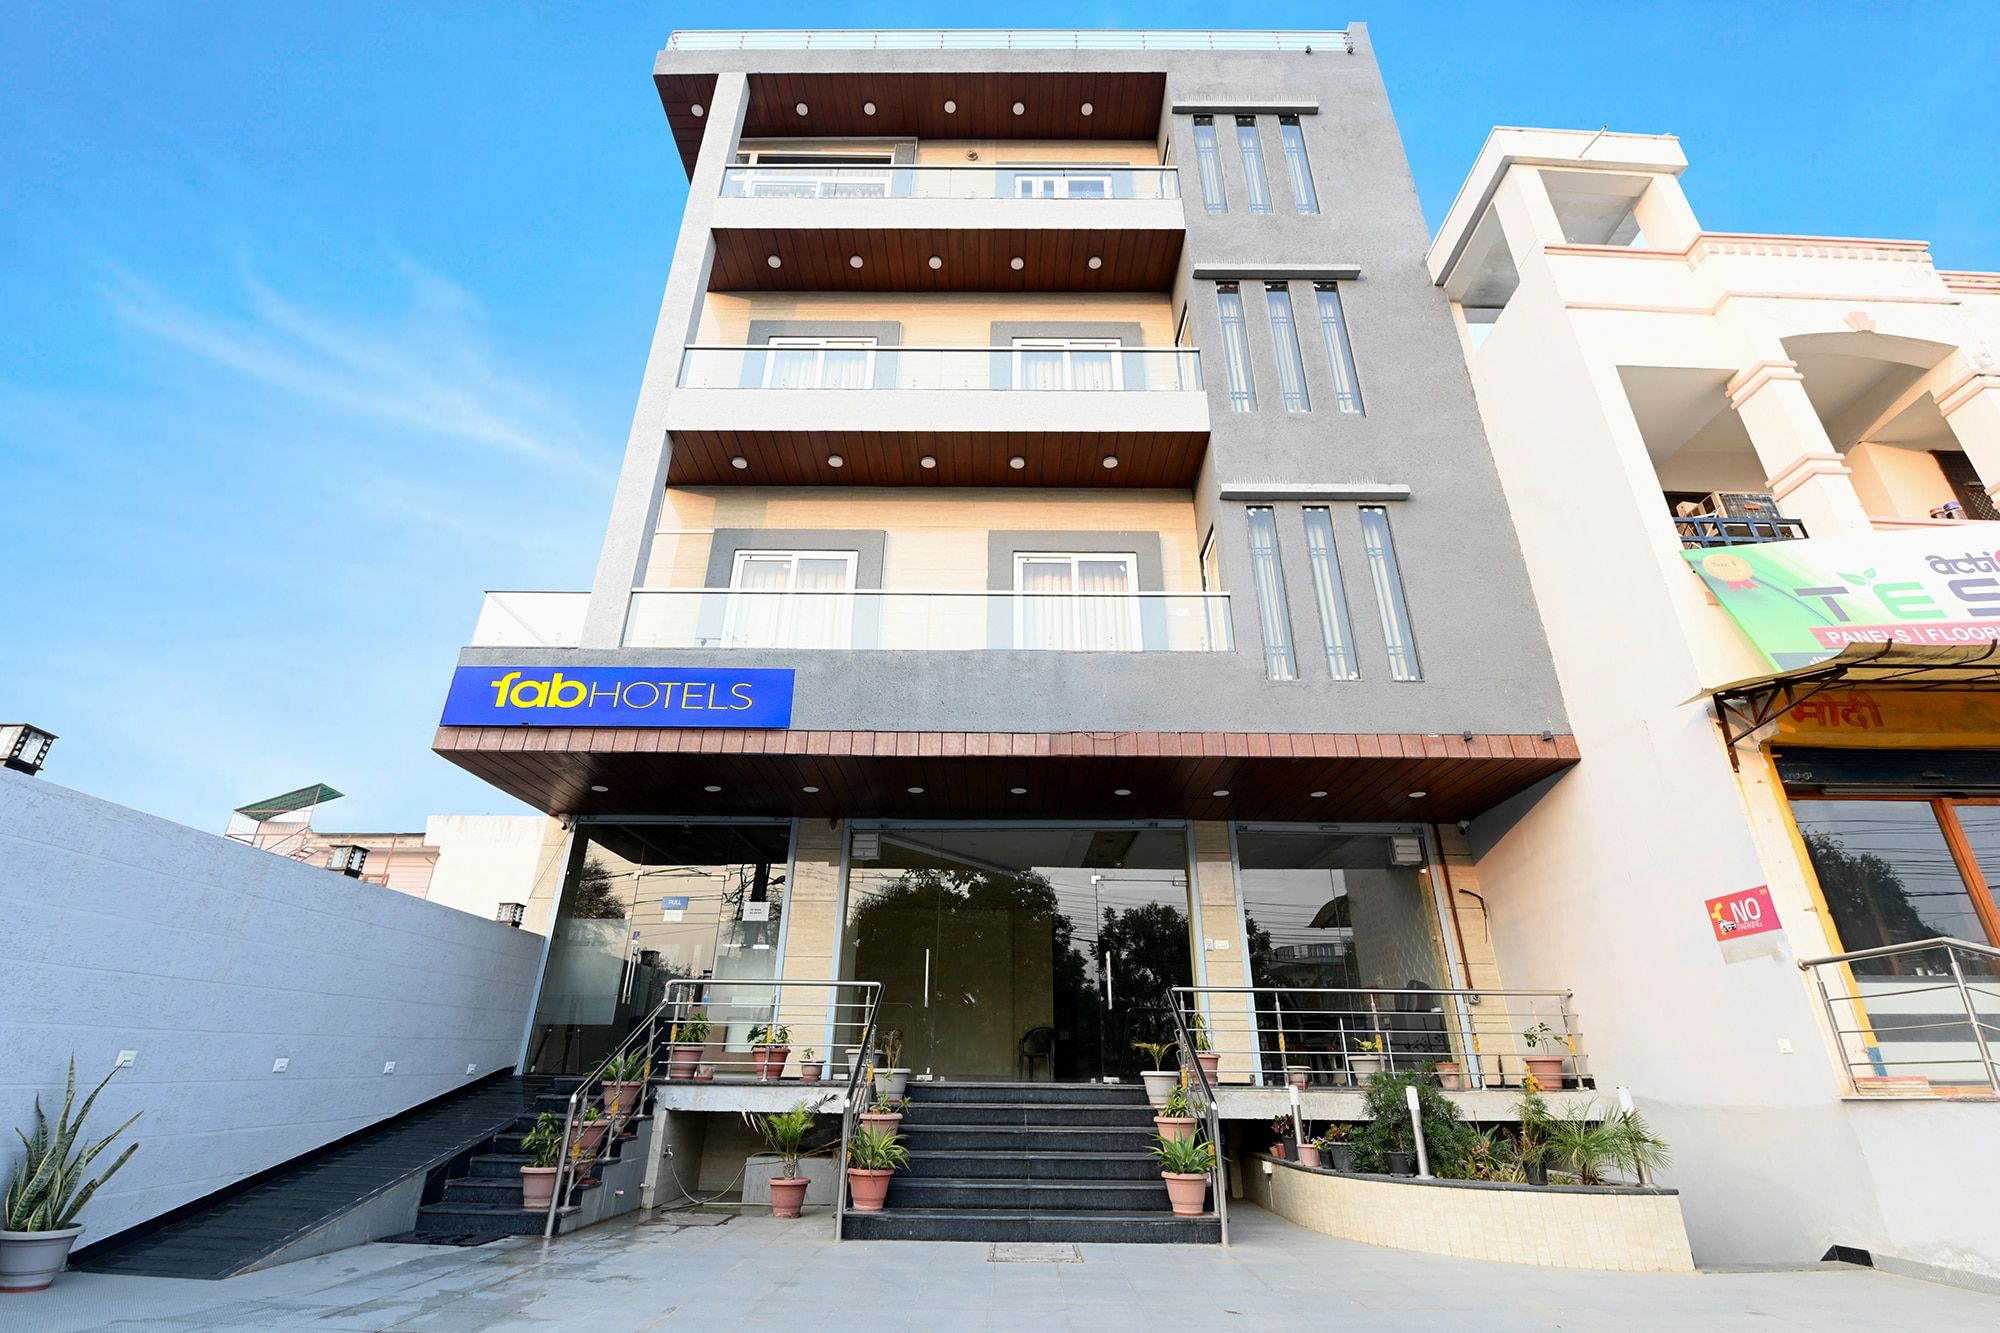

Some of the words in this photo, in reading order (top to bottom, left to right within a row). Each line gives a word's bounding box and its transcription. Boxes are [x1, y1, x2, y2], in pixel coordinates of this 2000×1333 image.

[1925, 549, 2000, 575] acti
[1825, 629, 1912, 643] PANELS
[1730, 897, 1761, 923] NO
[1736, 919, 1763, 931] PARKING
